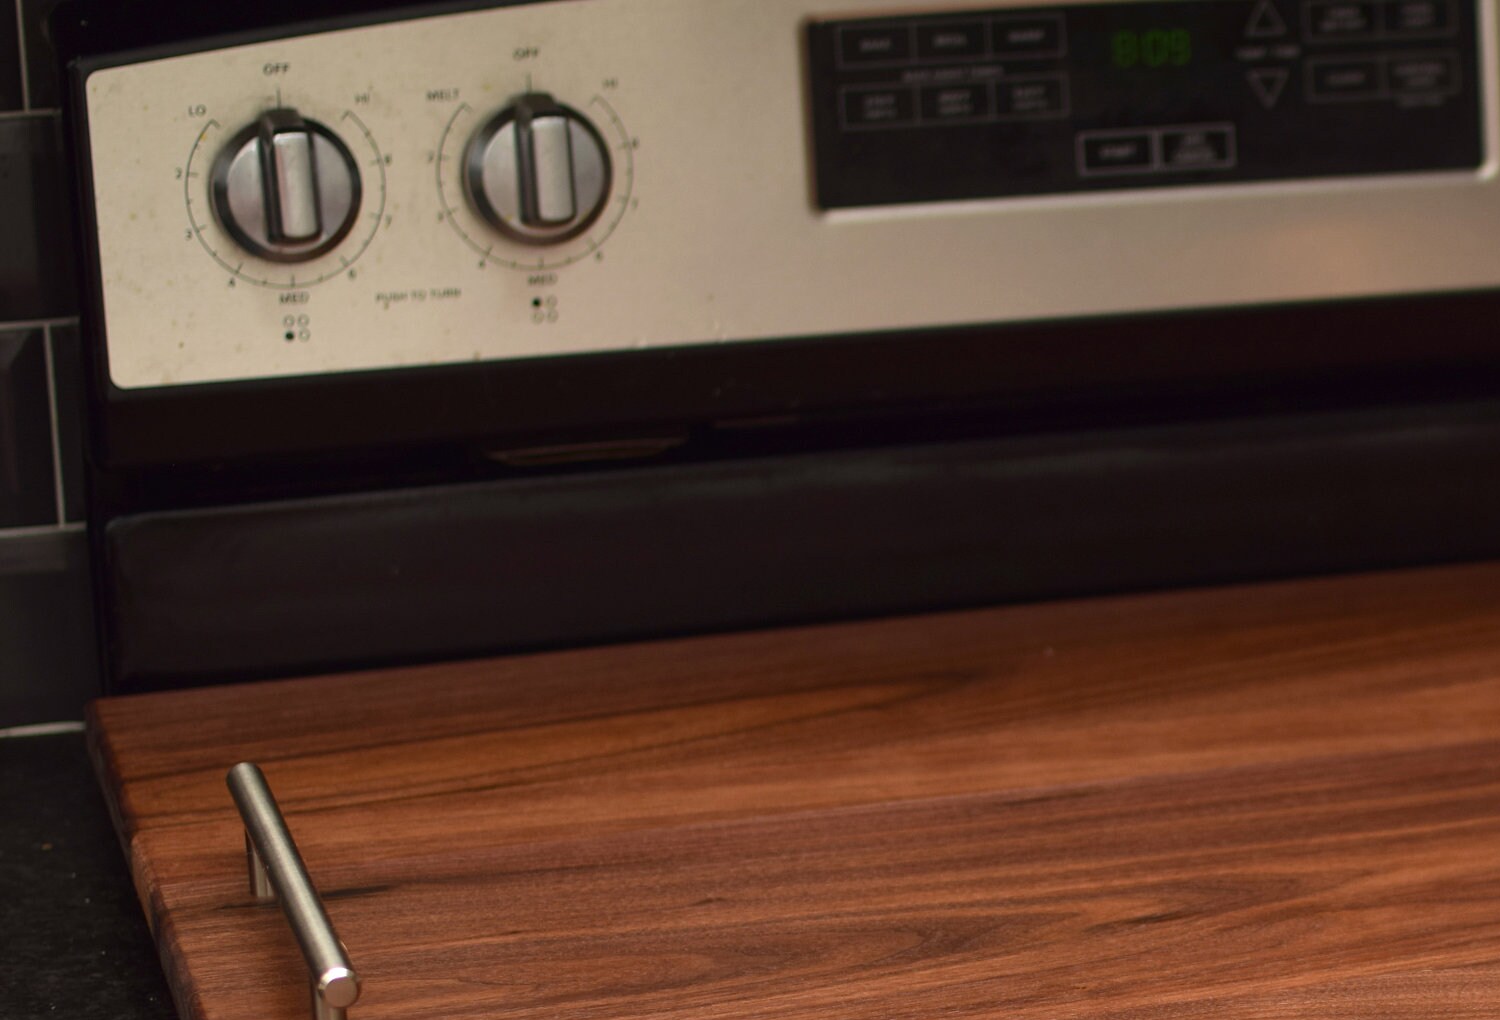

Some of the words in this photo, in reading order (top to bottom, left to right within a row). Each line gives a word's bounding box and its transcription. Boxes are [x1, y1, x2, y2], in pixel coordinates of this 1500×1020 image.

[512, 47, 540, 60] OFF
[262, 62, 291, 76] OFF
[426, 88, 460, 102] MELT
[188, 104, 207, 117] LO
[174, 166, 183, 180] 2
[527, 274, 559, 286] MED
[278, 291, 310, 305] MED
